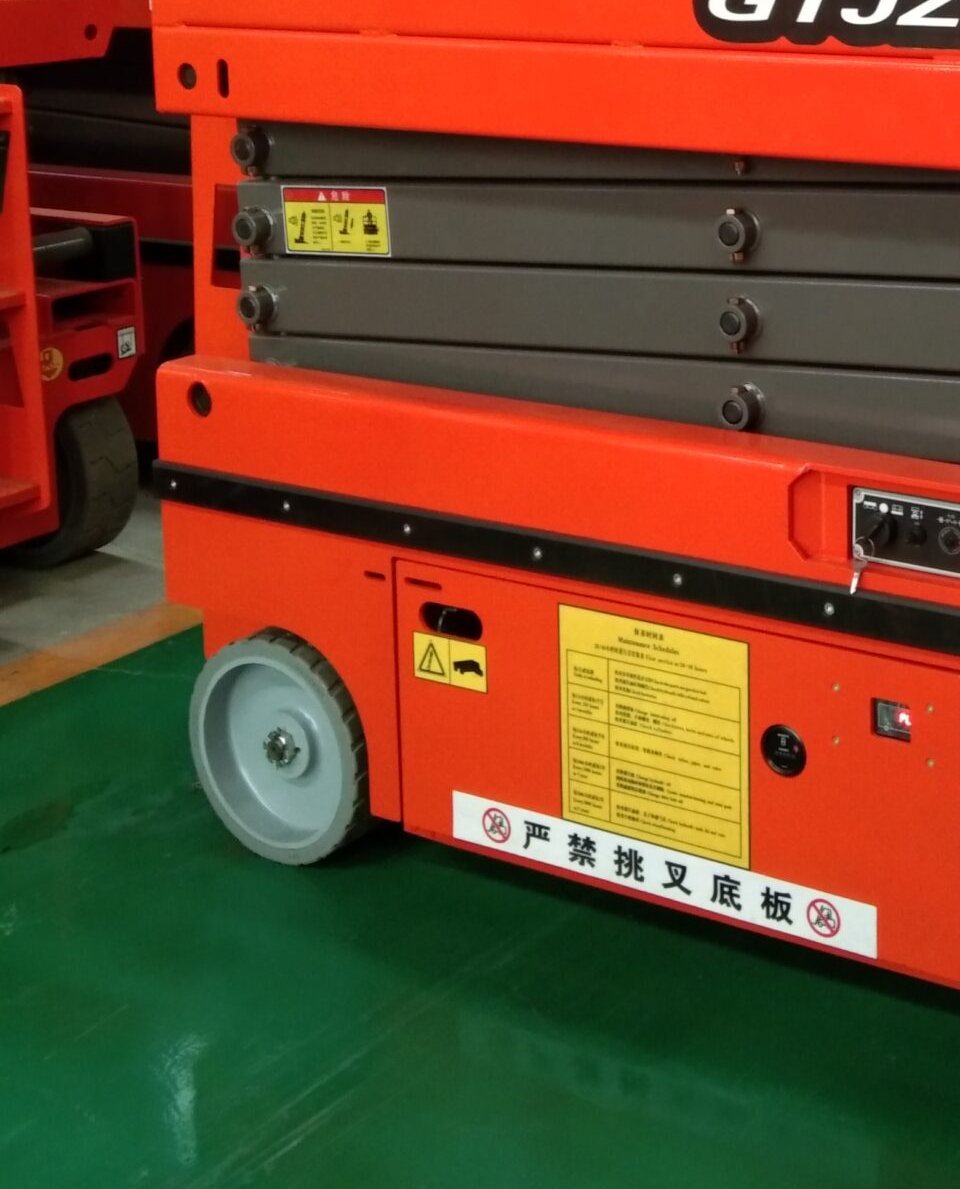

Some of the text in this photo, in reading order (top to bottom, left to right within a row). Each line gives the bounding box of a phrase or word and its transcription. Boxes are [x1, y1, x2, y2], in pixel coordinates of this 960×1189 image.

[523, 820, 794, 925] 严禁挑叉底板
